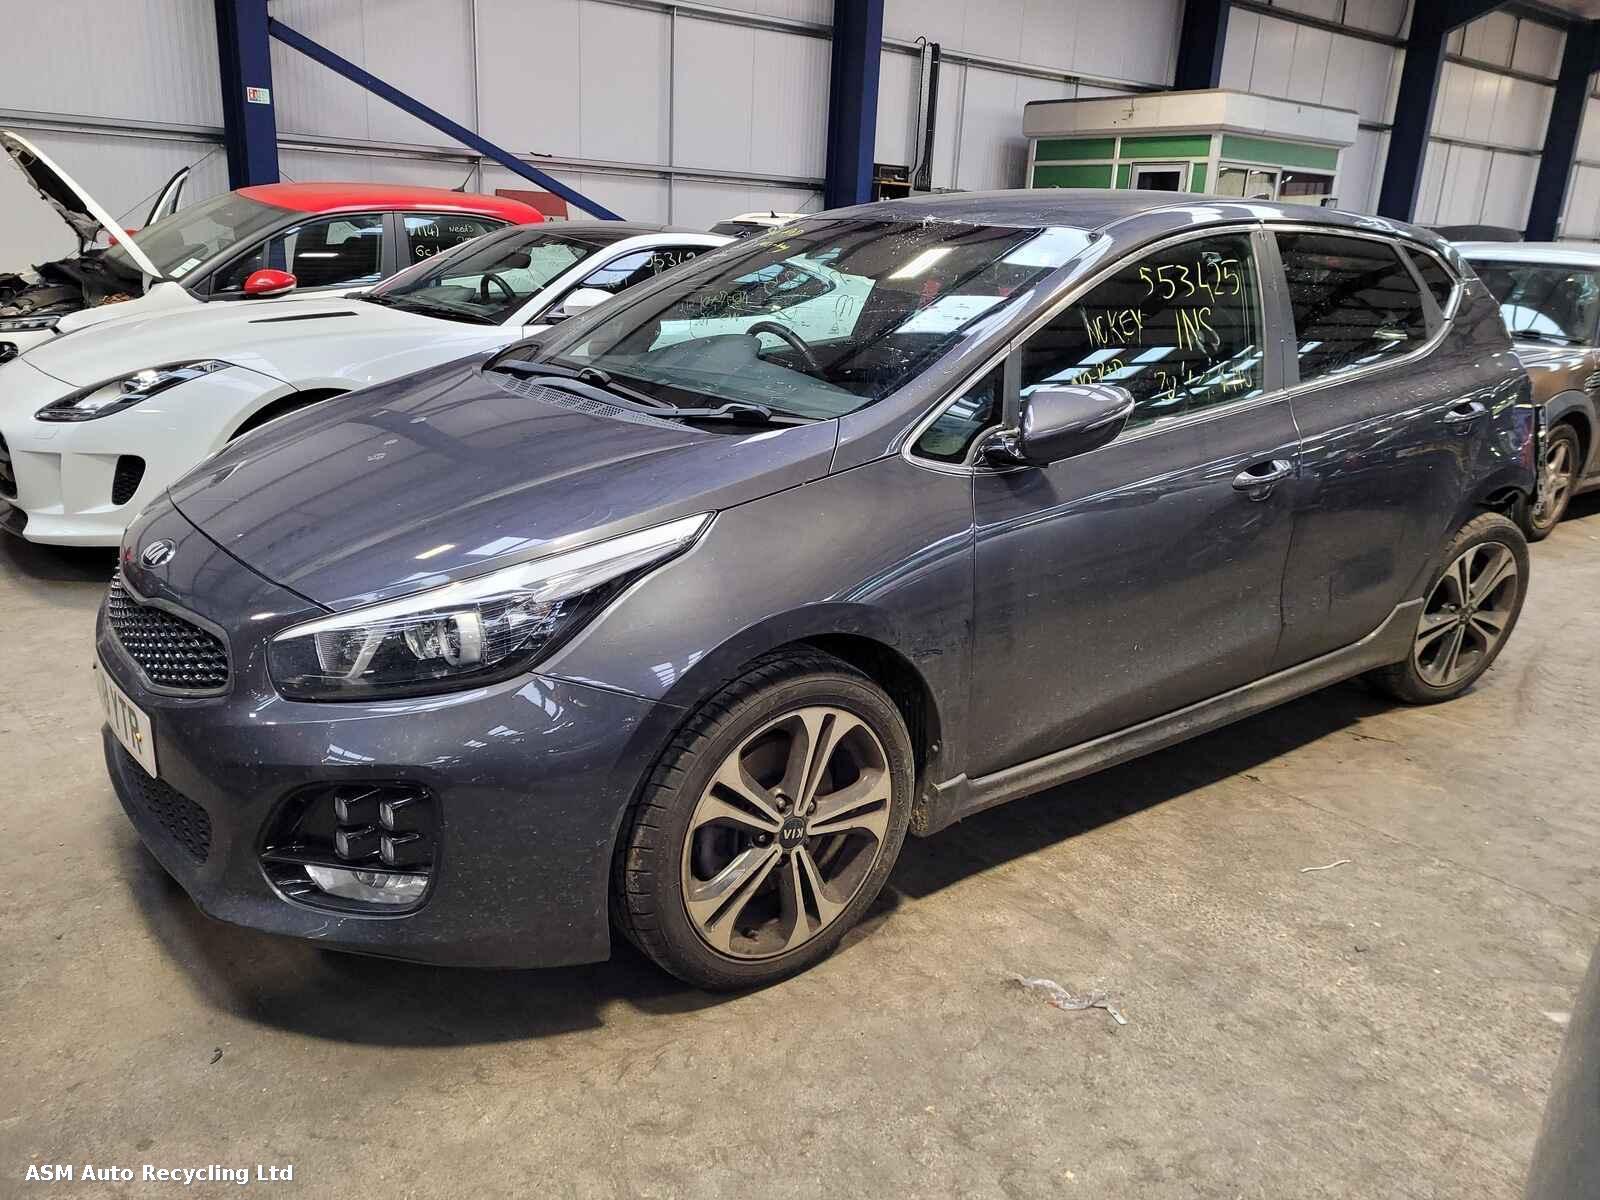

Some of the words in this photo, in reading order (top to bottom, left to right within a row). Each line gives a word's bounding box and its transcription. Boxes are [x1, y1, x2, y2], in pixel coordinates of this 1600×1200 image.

[1139, 259, 1241, 303] 553425
[1175, 307, 1221, 354] INS
[783, 827, 804, 841] KIA
